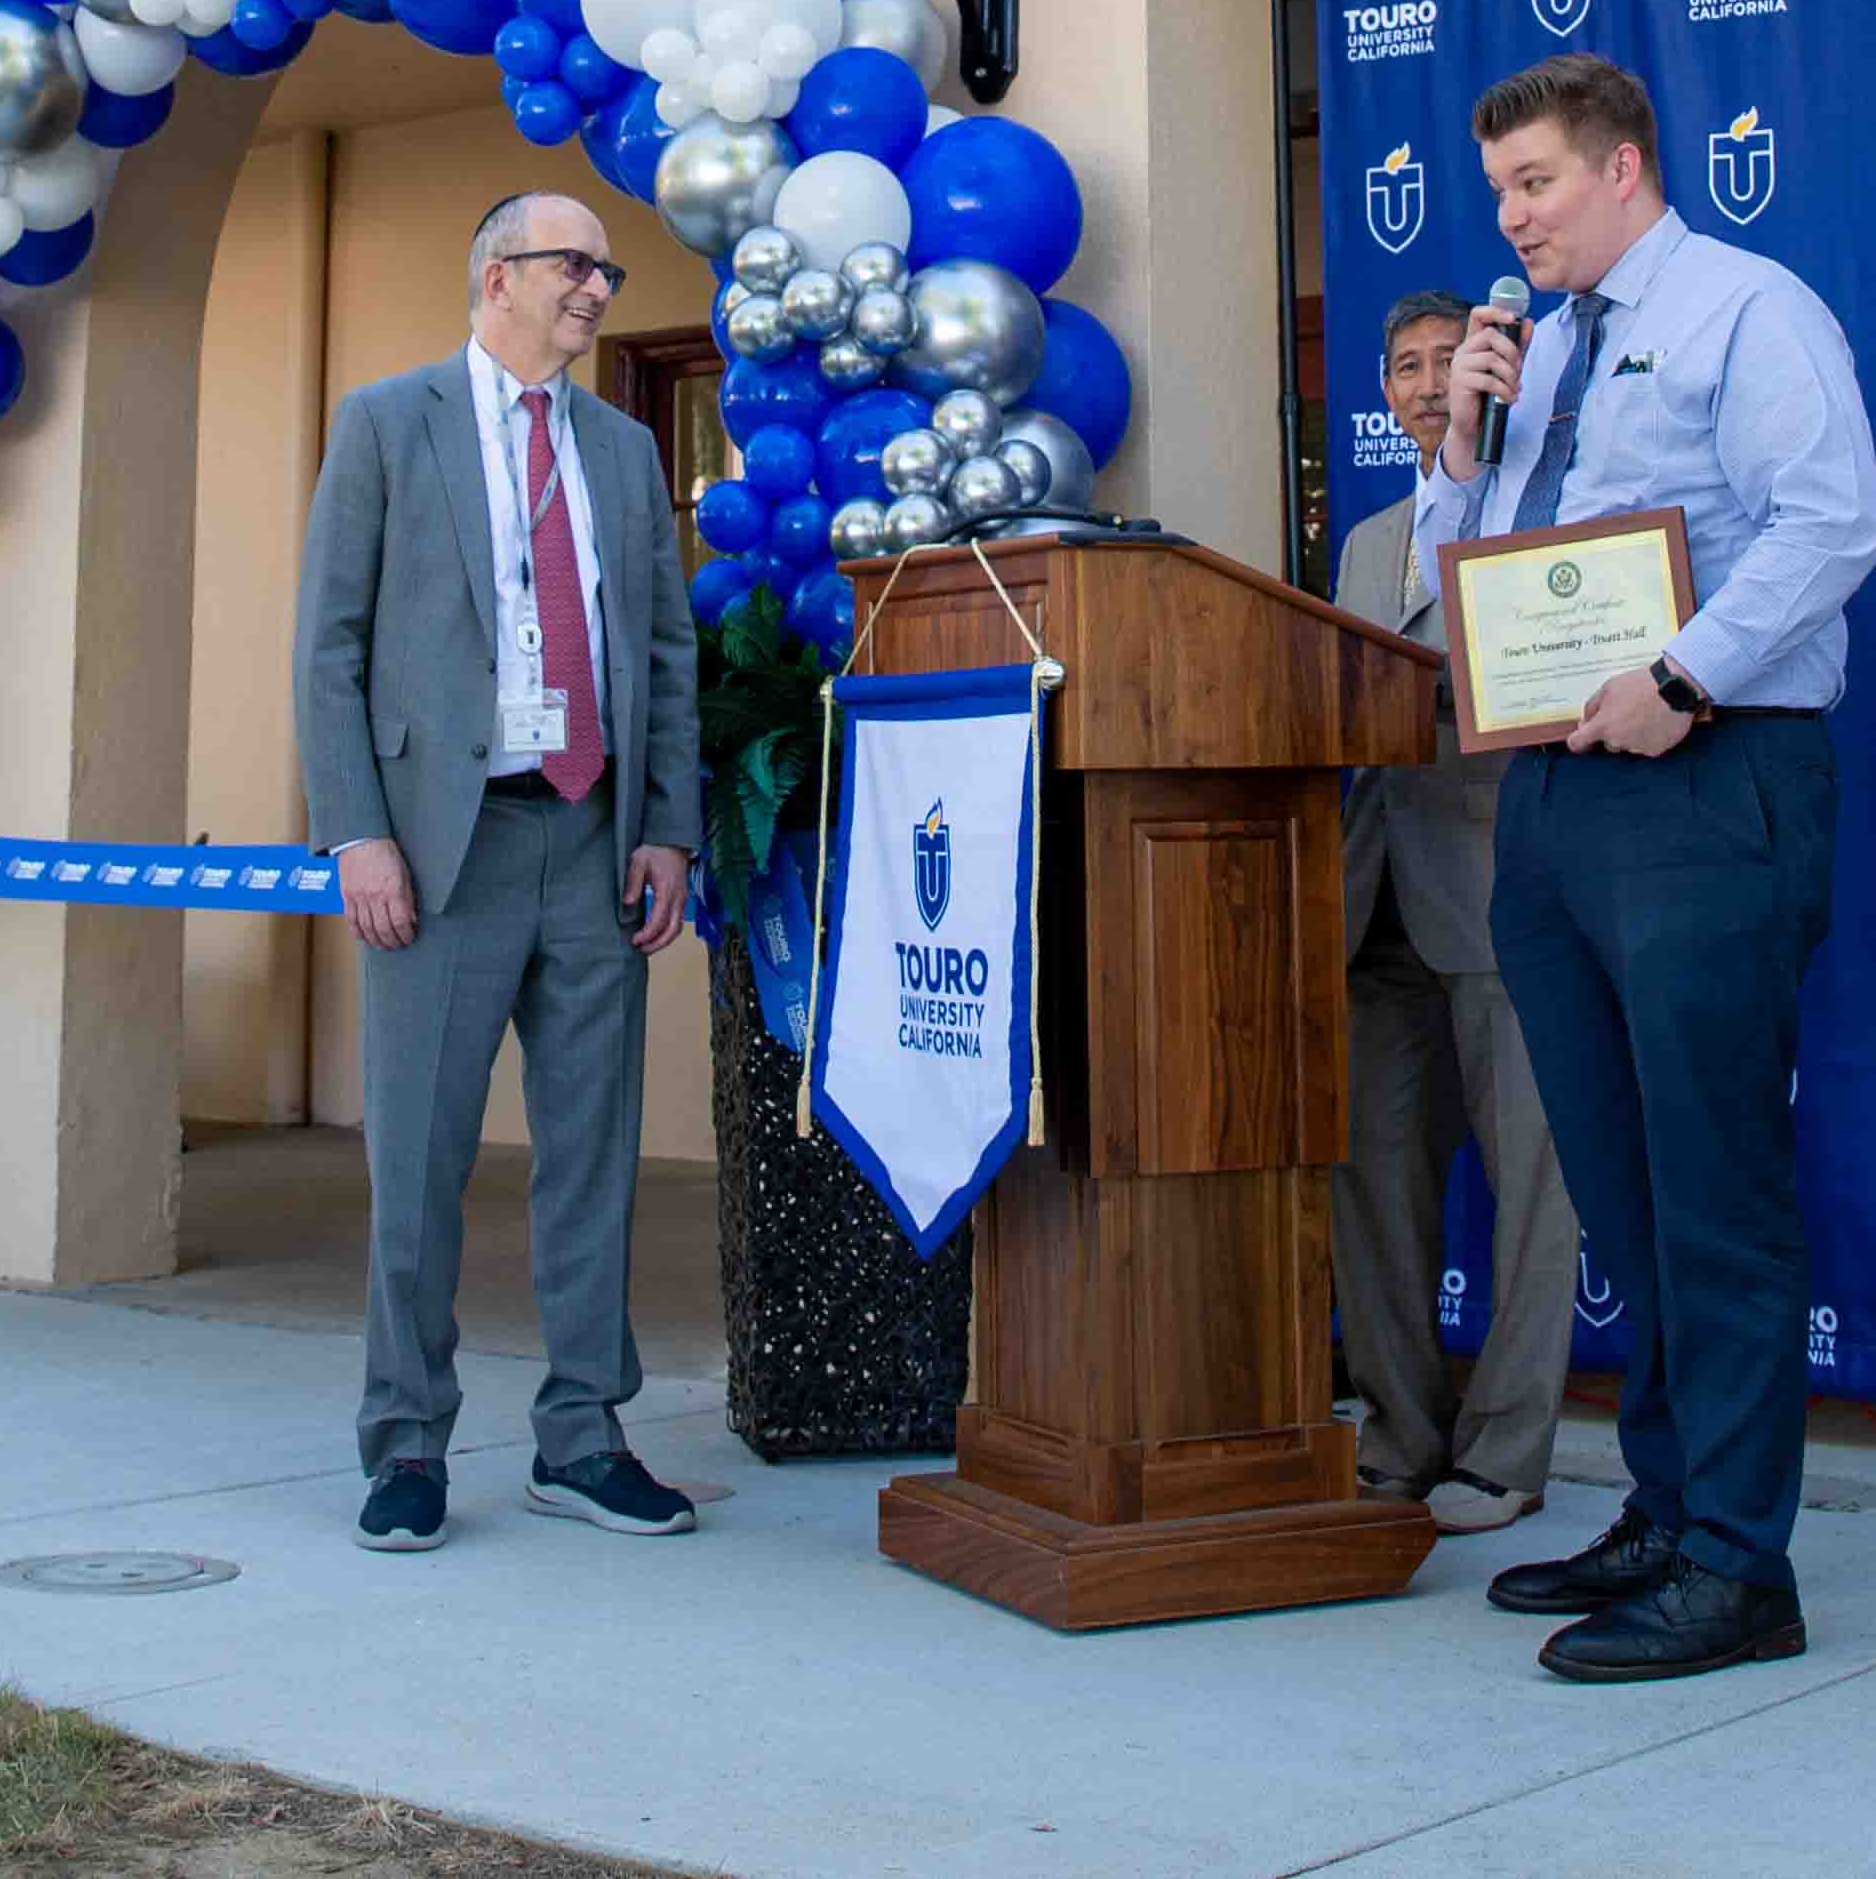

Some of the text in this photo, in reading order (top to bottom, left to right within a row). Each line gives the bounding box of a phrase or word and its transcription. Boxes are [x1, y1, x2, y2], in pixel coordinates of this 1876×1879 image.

[1344, 0, 1437, 33] TOURO
[1348, 26, 1433, 47] UNIVERSITY
[1348, 40, 1434, 61] CALIFORNIA
[1351, 412, 1404, 436] TOU
[1354, 436, 1419, 452] UNIVERS
[1353, 451, 1417, 466] CALIFOR
[895, 941, 989, 996] TOURO
[900, 994, 985, 1027] UNIVERSITY
[899, 1024, 982, 1058] CALIFORNIA
